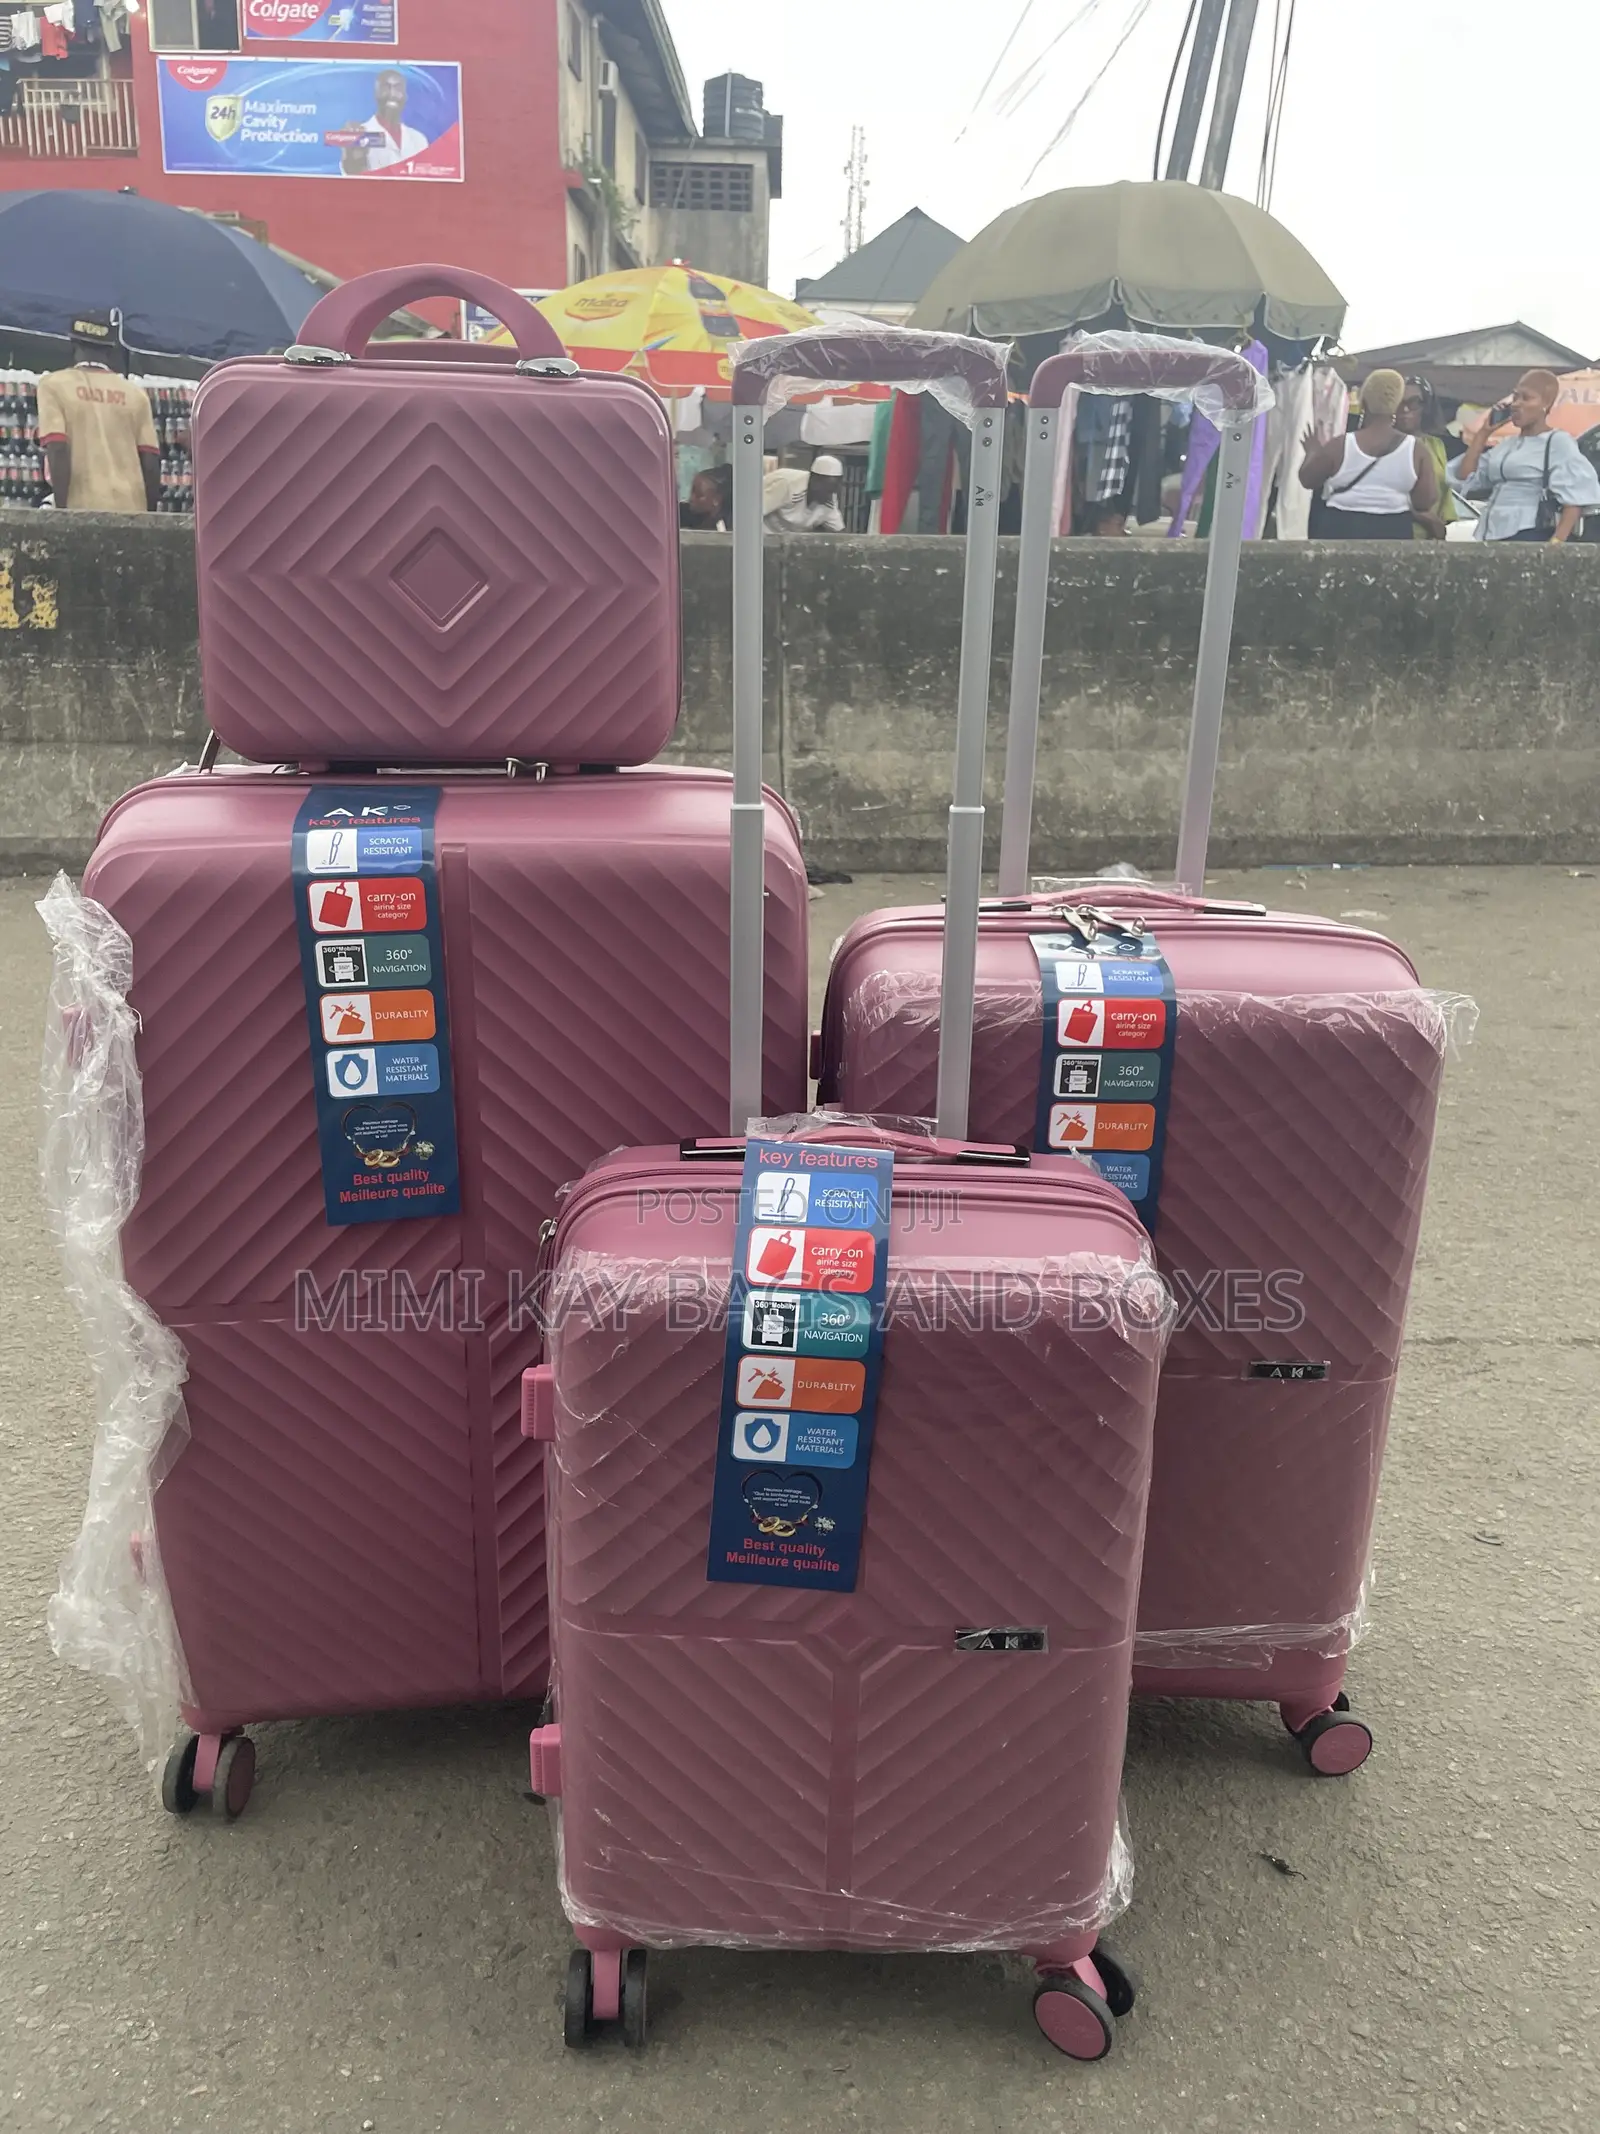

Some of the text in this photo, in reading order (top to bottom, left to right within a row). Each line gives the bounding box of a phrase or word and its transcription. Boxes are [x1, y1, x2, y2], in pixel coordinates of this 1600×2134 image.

[249, 0, 320, 23] Colgate
[210, 106, 236, 120] 24h
[244, 100, 317, 115] Maximum
[242, 115, 288, 130] Cavity
[240, 129, 319, 144] Protection
[308, 816, 421, 828] key features
[369, 837, 409, 846] SCRATCH
[366, 892, 416, 904] carry-on
[396, 902, 412, 910] size
[377, 911, 409, 920] category
[372, 963, 427, 974] NAVIGATION
[375, 1009, 429, 1021] DURABLITY
[1110, 1012, 1157, 1023] carry-on
[1137, 1022, 1152, 1030] size
[1118, 1030, 1148, 1039] category
[391, 1056, 420, 1065] WATER
[385, 1064, 428, 1074] RESISTANT
[385, 1073, 429, 1083] MATERIALS
[1104, 1079, 1155, 1088] NAVIGATION
[1097, 1121, 1149, 1132] DURABLITY
[759, 1148, 879, 1169] key features
[1106, 1165, 1133, 1173] WATER
[353, 1169, 430, 1186] Best quality
[1100, 1172, 1139, 1181] ESISTANT
[339, 1183, 446, 1204] Meilleure qualite
[822, 1188, 864, 1199] SCRATCH
[811, 1246, 864, 1260] carry-on
[841, 1259, 858, 1269] size
[818, 1267, 855, 1279] category
[803, 1330, 864, 1343] NAVIGATION
[797, 1380, 857, 1392] DURABLITY
[806, 1427, 837, 1437] WATER
[797, 1435, 845, 1446] RESISTANT
[795, 1443, 845, 1455] MATERIALS
[743, 1538, 826, 1557] Best quality
[726, 1551, 841, 1573] Meilleure qualite
